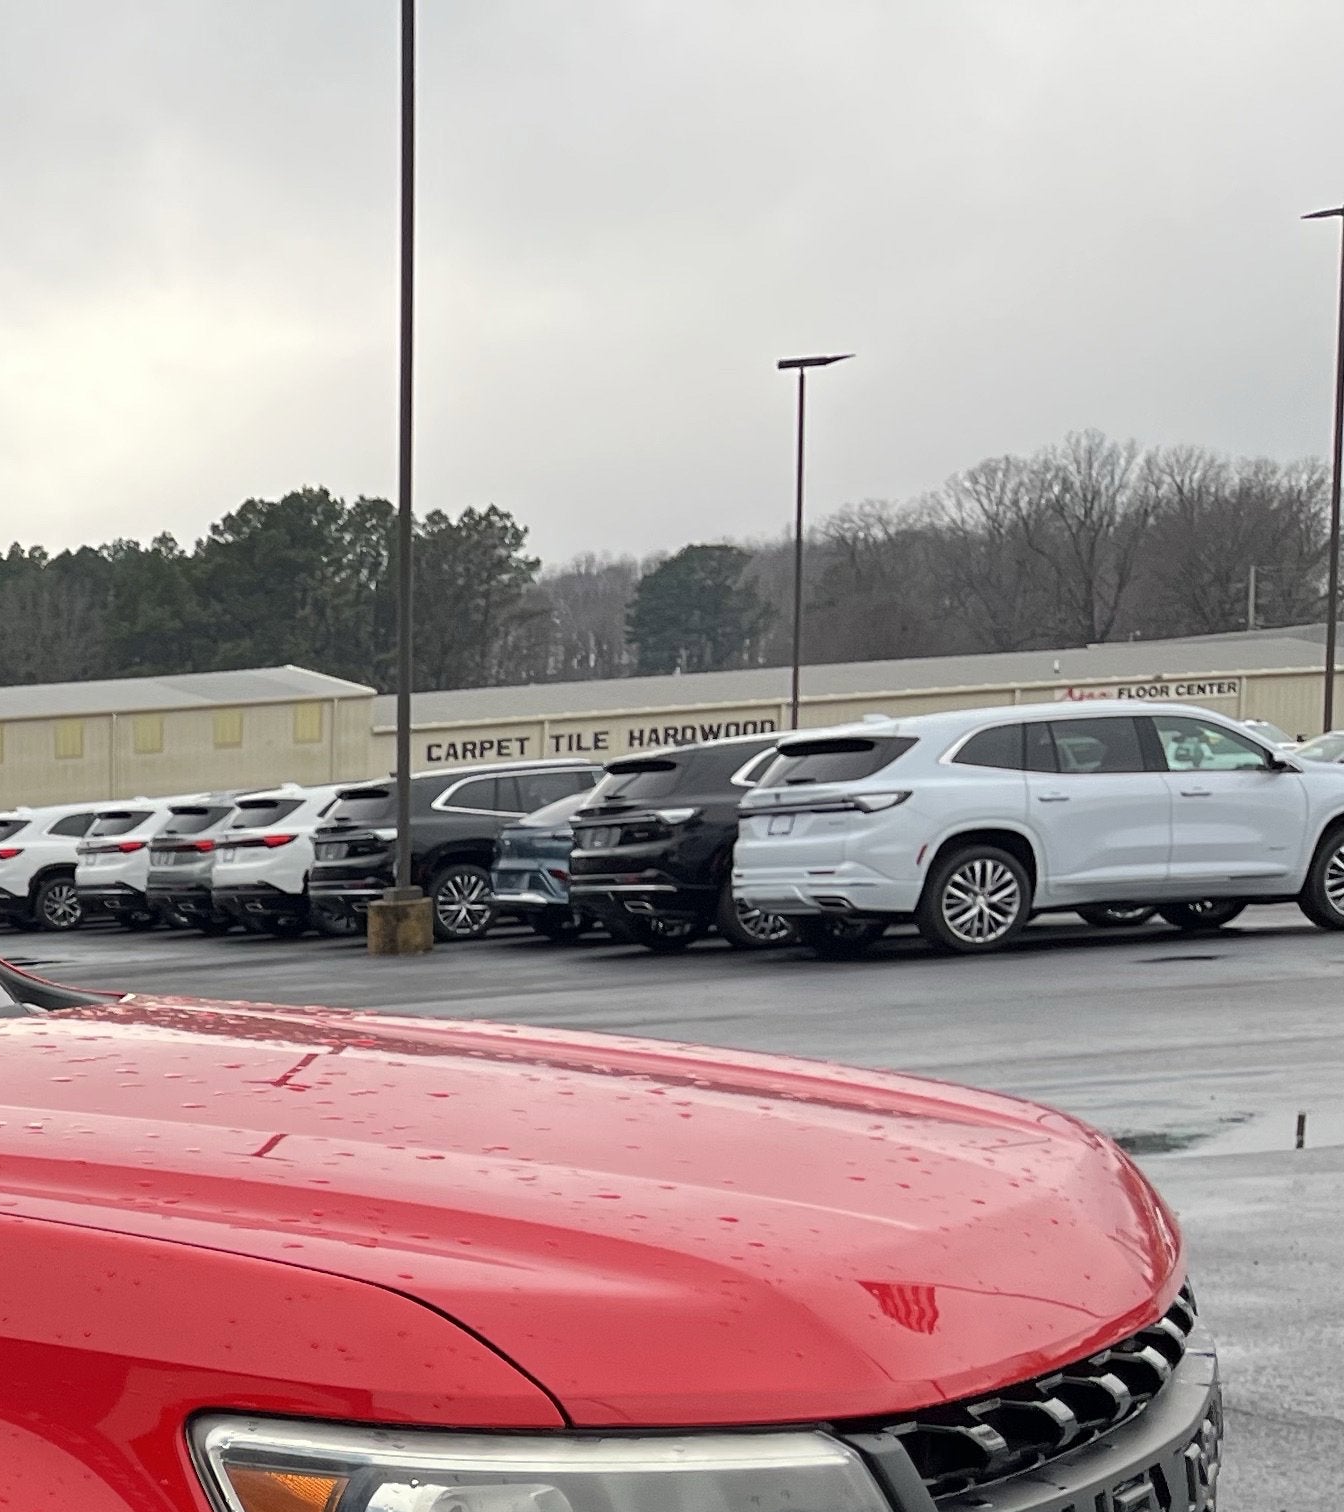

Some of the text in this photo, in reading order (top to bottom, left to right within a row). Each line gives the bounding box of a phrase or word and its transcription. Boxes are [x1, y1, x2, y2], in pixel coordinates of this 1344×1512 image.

[1117, 685, 1170, 699] FLOOR
[1175, 681, 1237, 697] CENTER
[426, 719, 777, 763] CARPET TILE HARDWOOD
